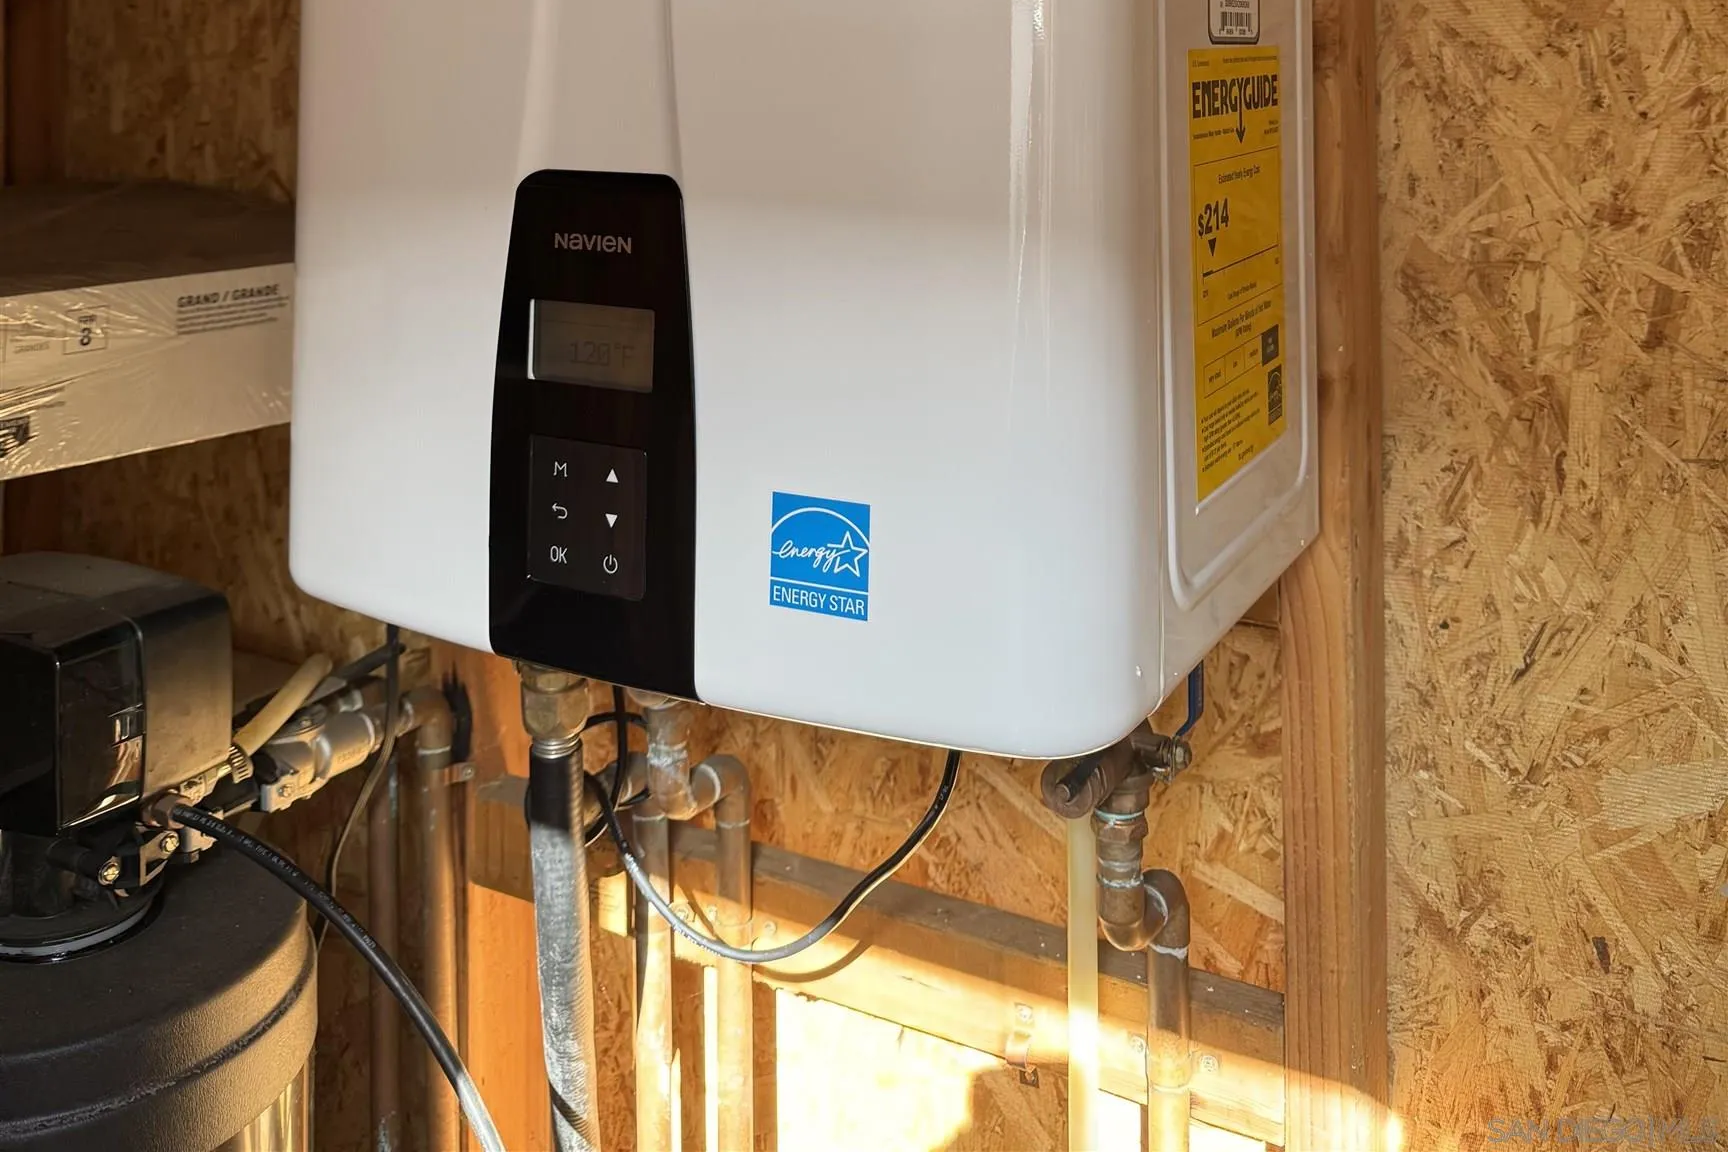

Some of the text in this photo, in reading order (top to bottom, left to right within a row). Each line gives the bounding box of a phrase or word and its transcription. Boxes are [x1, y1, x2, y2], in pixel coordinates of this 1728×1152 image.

[1191, 73, 1279, 120] ENERGYGUIDE
[1197, 198, 1230, 238] $214
[553, 461, 568, 478] M
[550, 545, 568, 565] OK
[773, 585, 865, 616] ENERGY STAR
